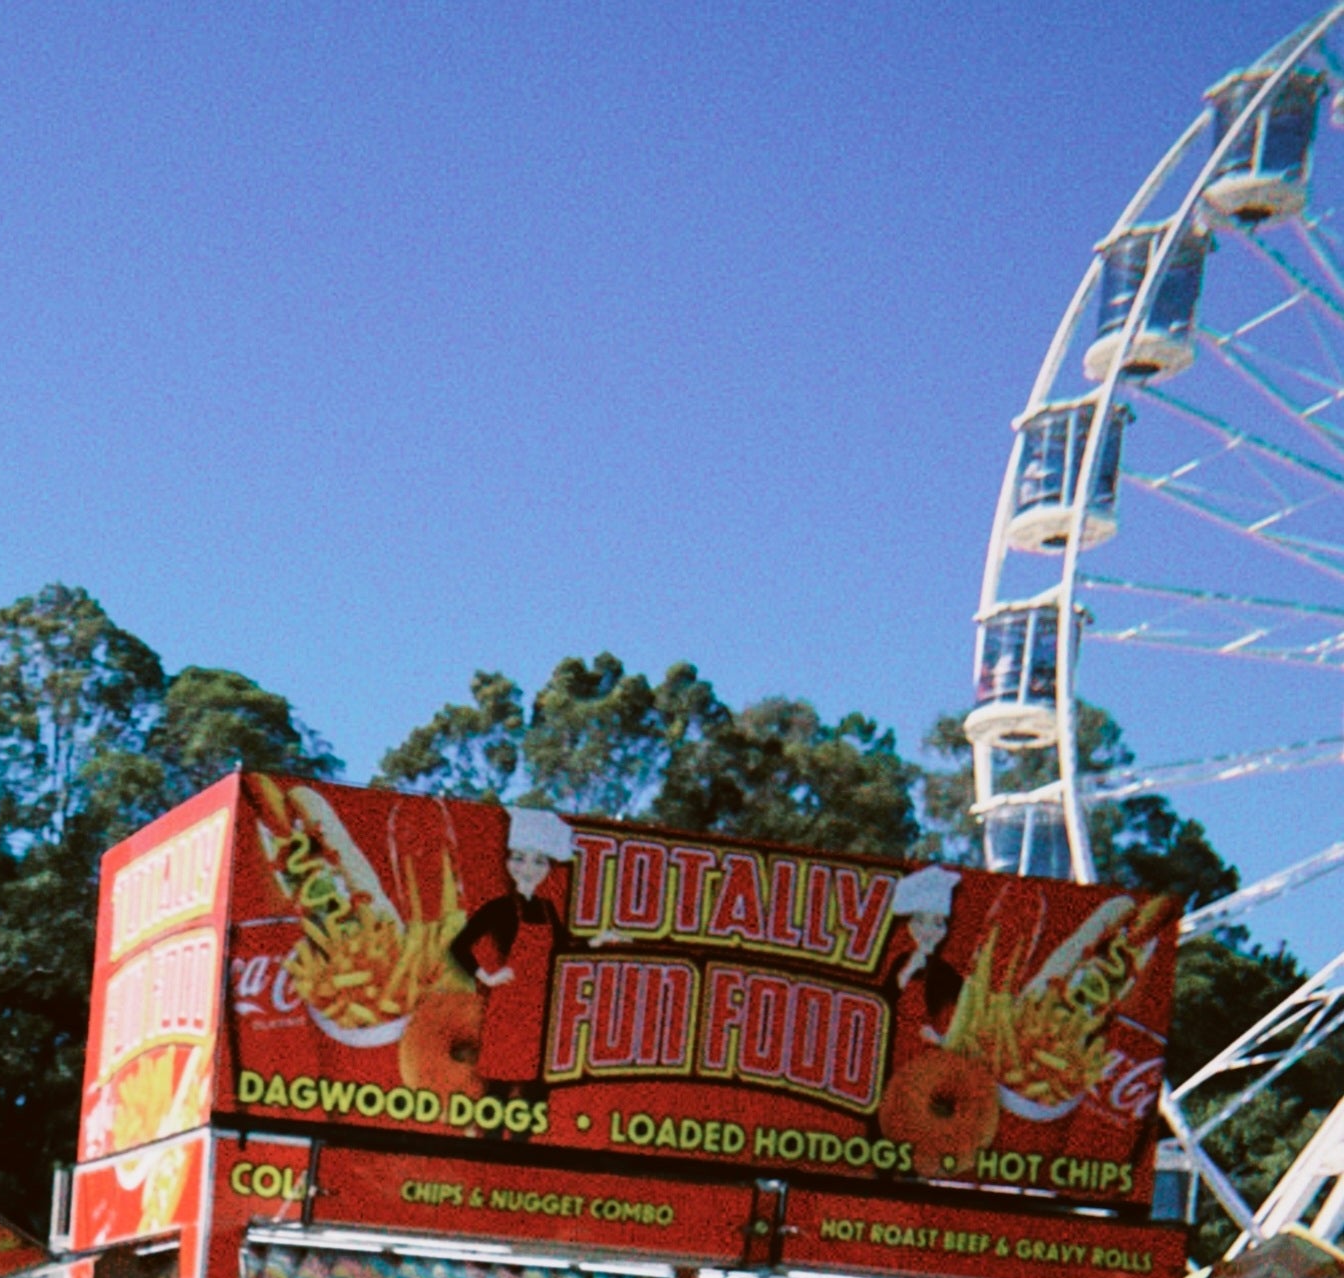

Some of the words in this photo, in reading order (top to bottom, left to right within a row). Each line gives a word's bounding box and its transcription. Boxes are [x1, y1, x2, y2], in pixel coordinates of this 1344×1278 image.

[570, 832, 898, 967] TOTALLY
[547, 960, 698, 1076] FUN
[701, 967, 887, 1112] FOOD
[238, 1070, 441, 1123] DAGWOOD
[448, 1093, 549, 1134] DOGS
[611, 1111, 746, 1153] LOADED
[753, 1127, 913, 1171] HOTDOGS
[977, 1151, 1043, 1184] HOT
[1049, 1156, 1133, 1192] CHIPS
[401, 1181, 464, 1207] CHIPS
[468, 1187, 485, 1208] &
[489, 1189, 584, 1217] NUGGET
[589, 1198, 674, 1226] COMBO
[820, 1218, 865, 1242] HOT
[869, 1223, 938, 1248] ROAST
[942, 1230, 991, 1253] BEEF
[995, 1237, 1009, 1256] &
[1015, 1239, 1087, 1264] GRAVY
[1091, 1248, 1152, 1272] ROLLS
